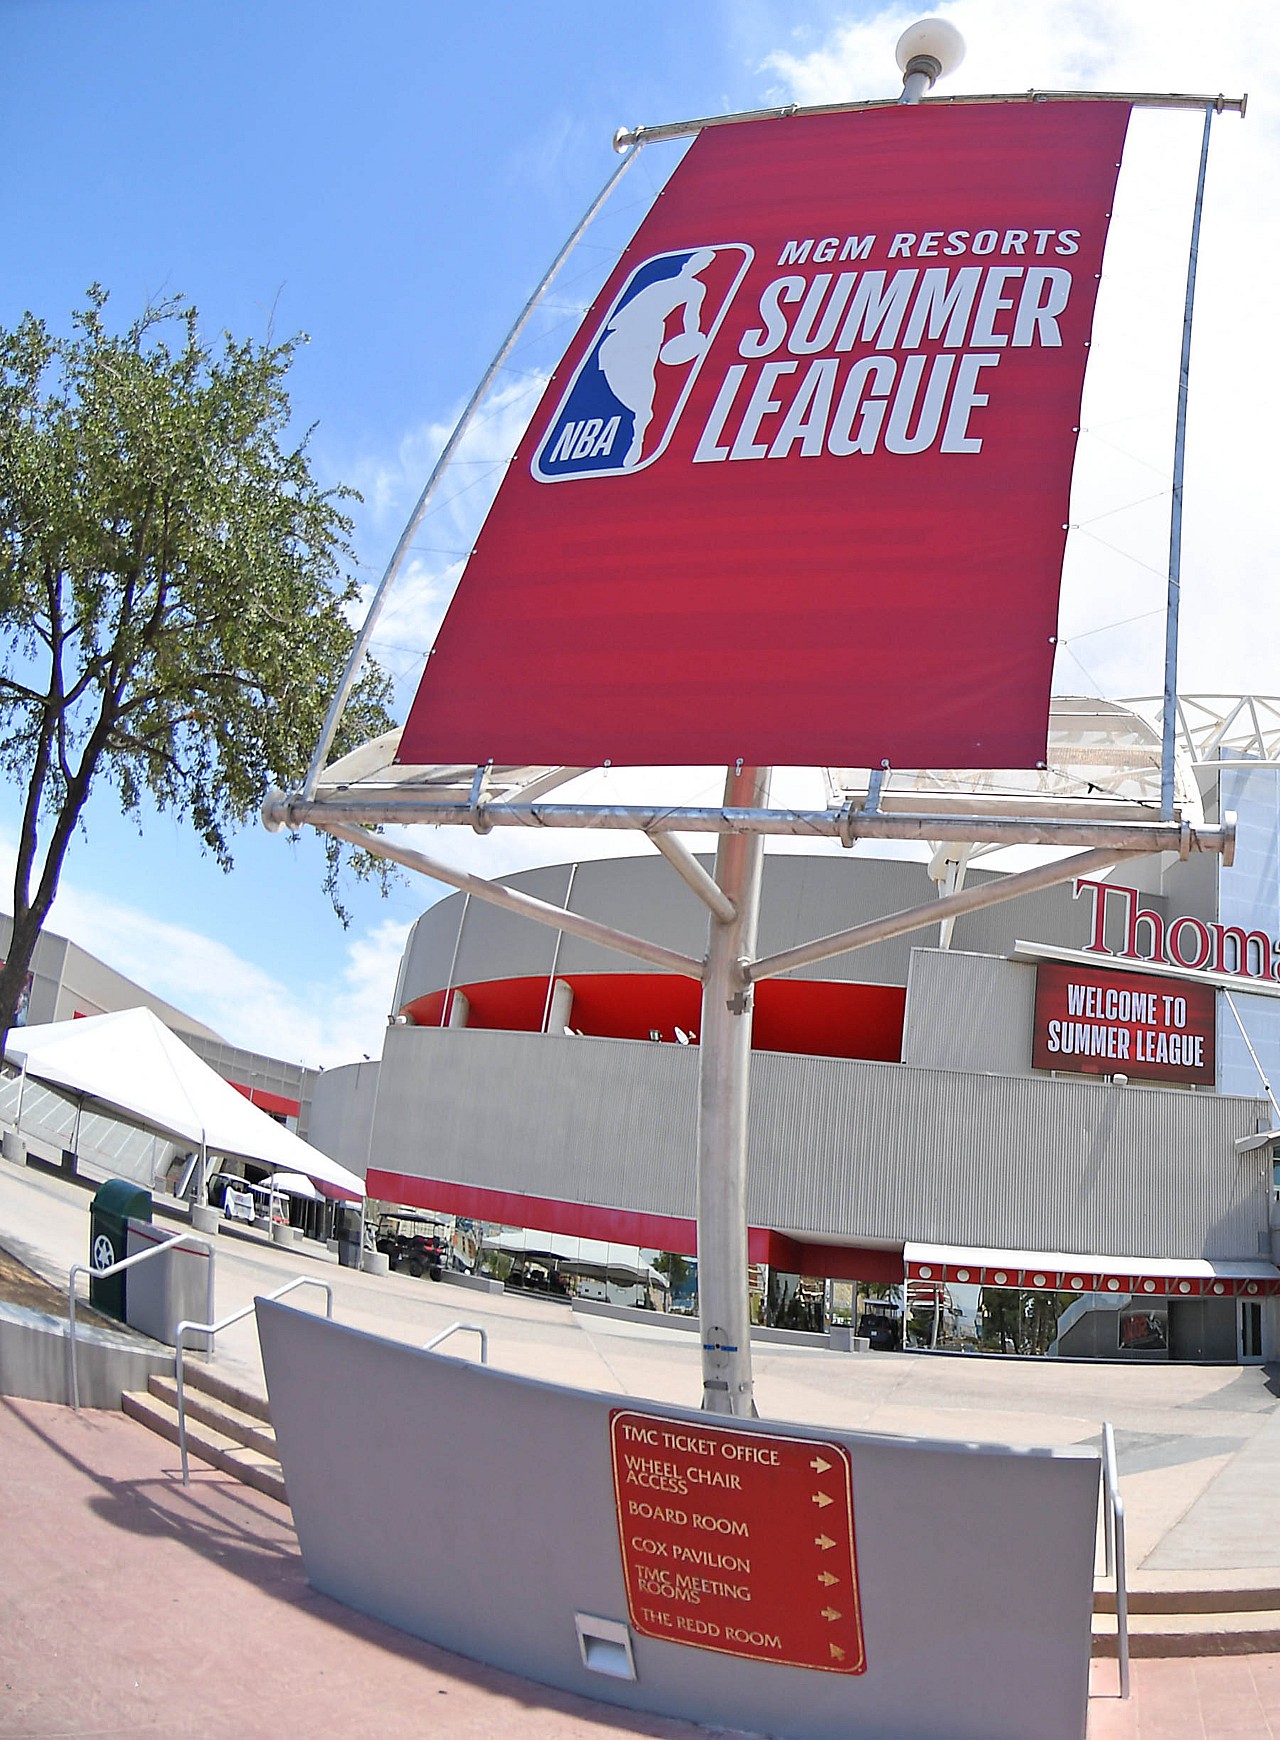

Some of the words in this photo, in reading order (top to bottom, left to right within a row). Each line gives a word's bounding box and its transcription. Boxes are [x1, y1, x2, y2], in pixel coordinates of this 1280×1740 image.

[777, 235, 876, 266] MGM
[887, 229, 1081, 259] RESORTS
[738, 266, 1074, 359] SUMMER
[692, 353, 1000, 464] LEAGUE
[549, 415, 622, 463] NBA
[1067, 984, 1158, 1025] WELCOME
[1162, 995, 1187, 1028] TO
[1047, 1020, 1130, 1060] SUMMER
[1136, 1029, 1204, 1067] LEAGUE
[622, 1424, 658, 1447] TMC
[662, 1432, 717, 1456] TICKET
[721, 1443, 781, 1467] OFFICE
[624, 1454, 682, 1480] WHEEL
[686, 1467, 742, 1491] CHAIR
[626, 1471, 689, 1496] ACCESS
[628, 1500, 688, 1526] BOARD
[692, 1513, 750, 1538] ROOM
[631, 1536, 668, 1557] COX
[672, 1546, 750, 1574] PAVILION
[635, 1564, 671, 1584] TMC
[675, 1573, 751, 1602] MEETING
[637, 1578, 701, 1605] ROOMS
[641, 1607, 673, 1628] THE
[676, 1616, 720, 1638] REDD
[725, 1626, 782, 1650] ROOM
